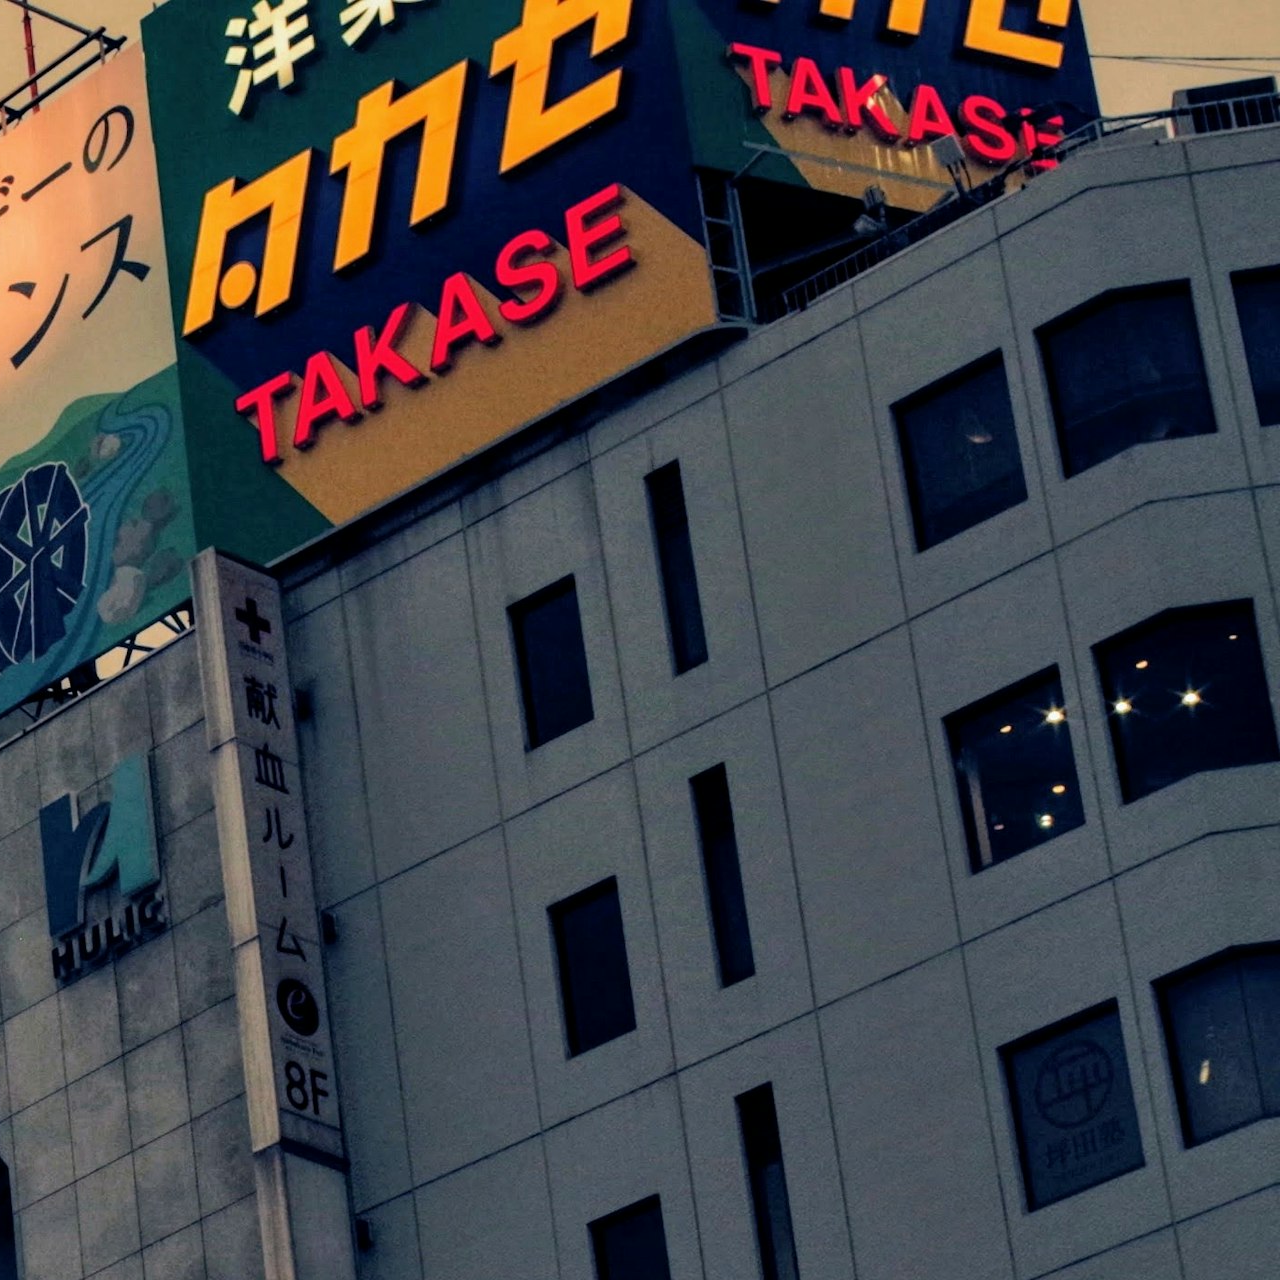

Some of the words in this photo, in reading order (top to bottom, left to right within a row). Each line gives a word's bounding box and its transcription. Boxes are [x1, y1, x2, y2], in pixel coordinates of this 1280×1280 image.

[183, 0, 632, 338] タカセ
[234, 182, 637, 466] TAKASE
[51, 892, 167, 980] HULIC
[243, 674, 308, 964] 献血ルーム
[283, 1059, 330, 1116] 8F
